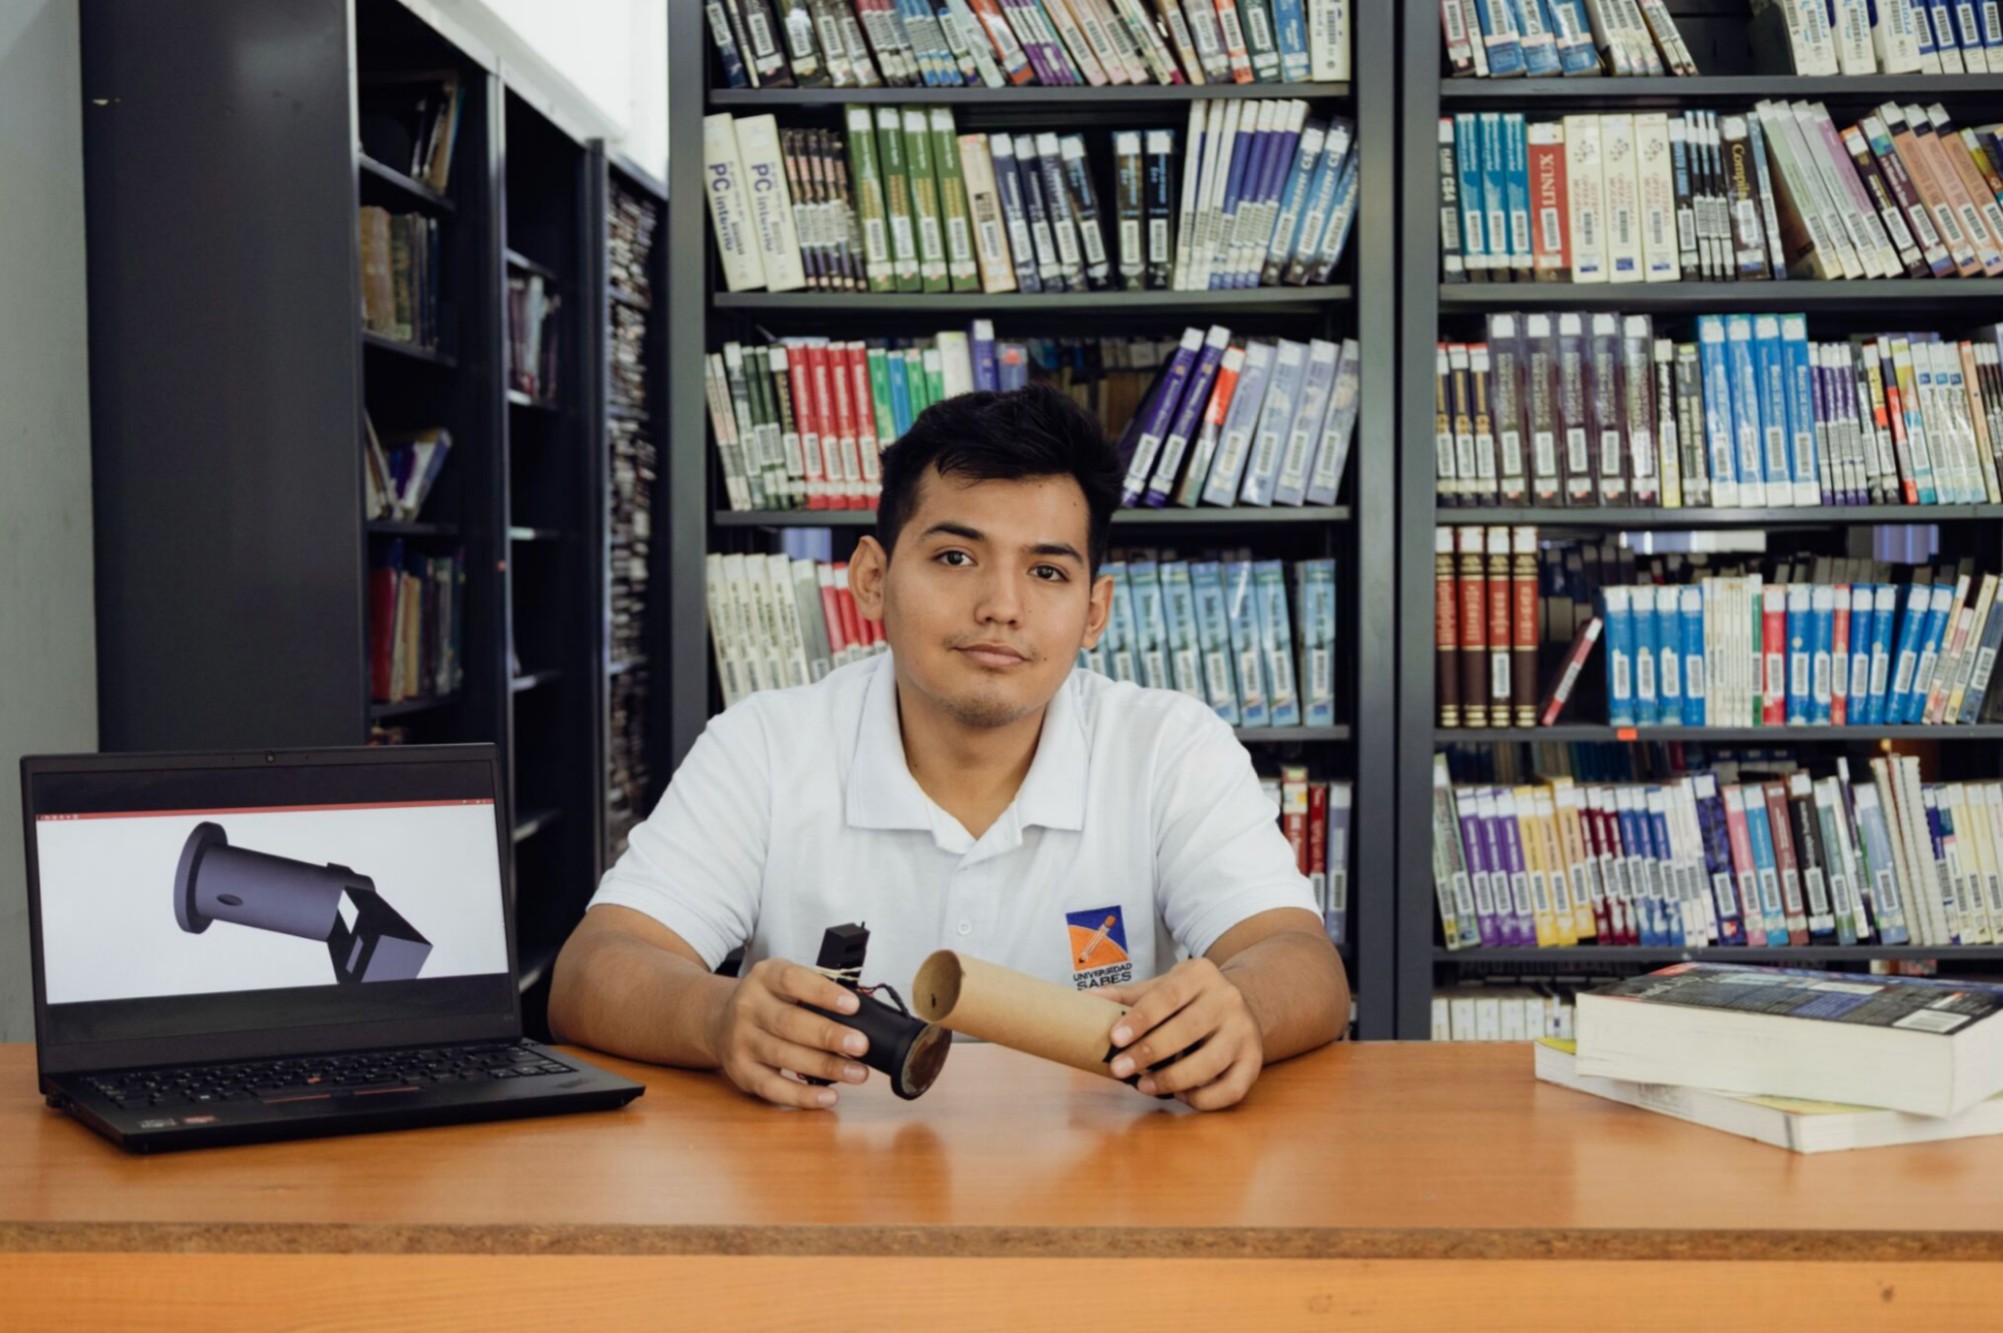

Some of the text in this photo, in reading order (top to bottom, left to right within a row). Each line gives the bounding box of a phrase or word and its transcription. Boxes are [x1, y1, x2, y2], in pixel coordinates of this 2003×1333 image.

[708, 162, 731, 193] PC
[751, 163, 772, 193] PC
[1540, 153, 1556, 206] LINUX
[1073, 963, 1132, 981] UNIVERSIDAD
[1077, 971, 1132, 991] SABES
